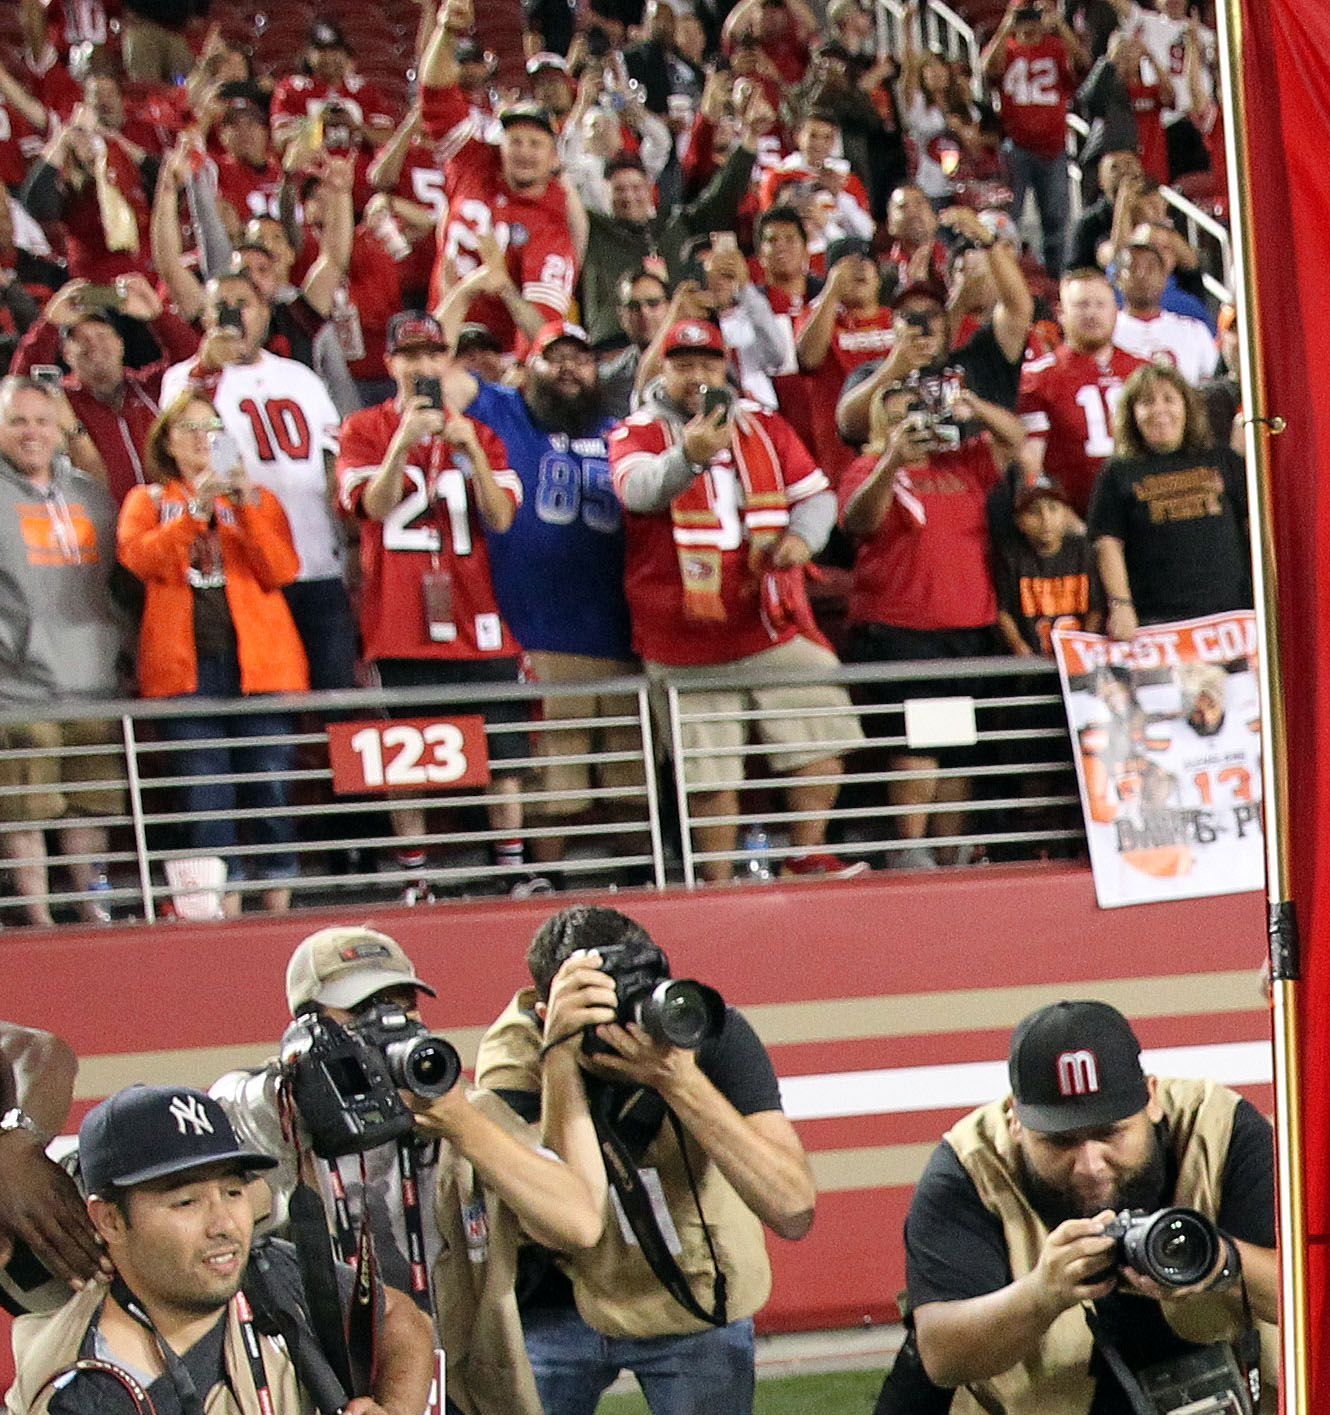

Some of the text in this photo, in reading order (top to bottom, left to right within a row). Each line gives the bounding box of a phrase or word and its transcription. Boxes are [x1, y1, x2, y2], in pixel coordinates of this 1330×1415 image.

[1003, 56, 1059, 106] 42
[239, 398, 311, 461] 10
[382, 464, 472, 556] 21
[351, 723, 468, 786] 123
[168, 1095, 215, 1136] NY
